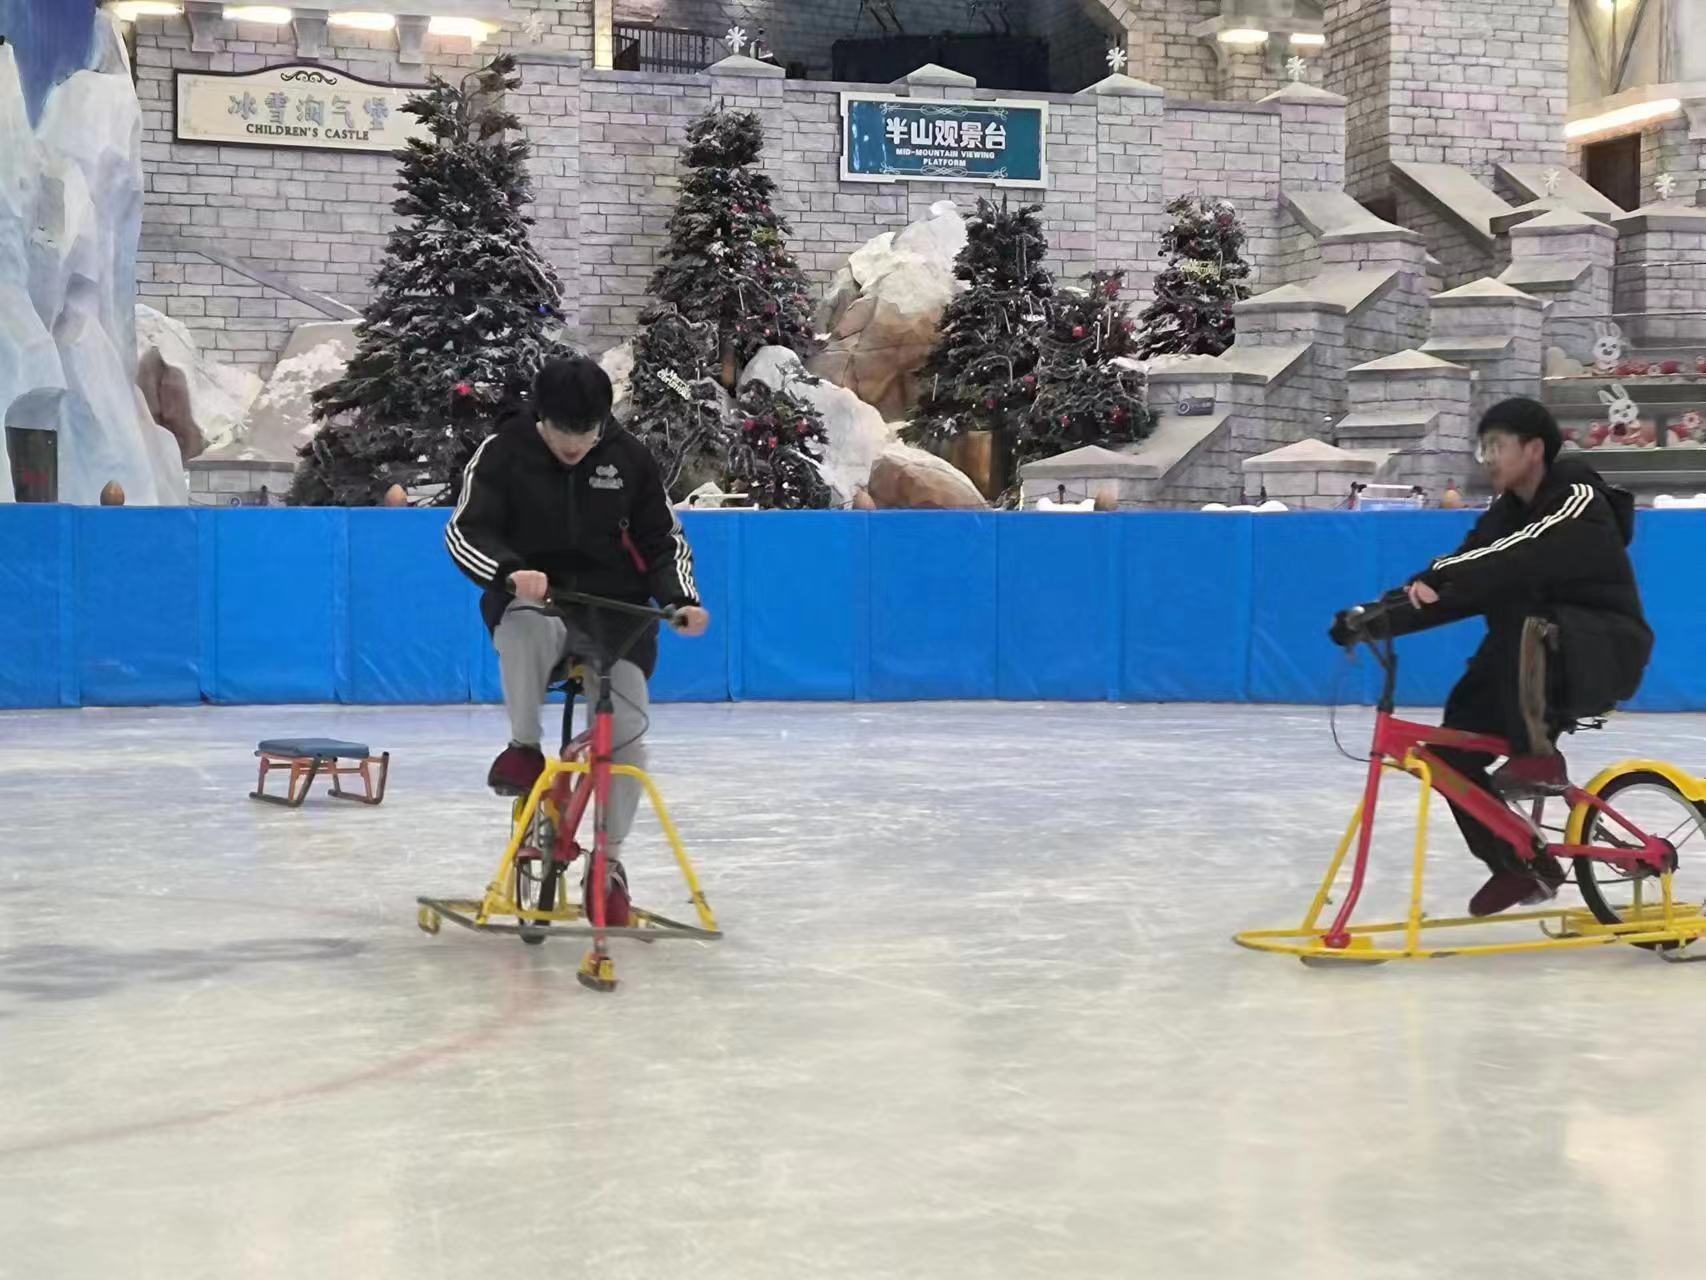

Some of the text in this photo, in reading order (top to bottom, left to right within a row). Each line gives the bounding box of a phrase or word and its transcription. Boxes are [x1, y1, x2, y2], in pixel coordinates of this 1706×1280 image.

[227, 91, 389, 131] 冰雪淘气堡
[246, 123, 369, 141] CHILDREN'S CASTLE
[885, 116, 1007, 150] 半山观景台
[895, 148, 995, 159] MID-MOUNTAIN VIEWING
[923, 158, 967, 167] PLATFORM
